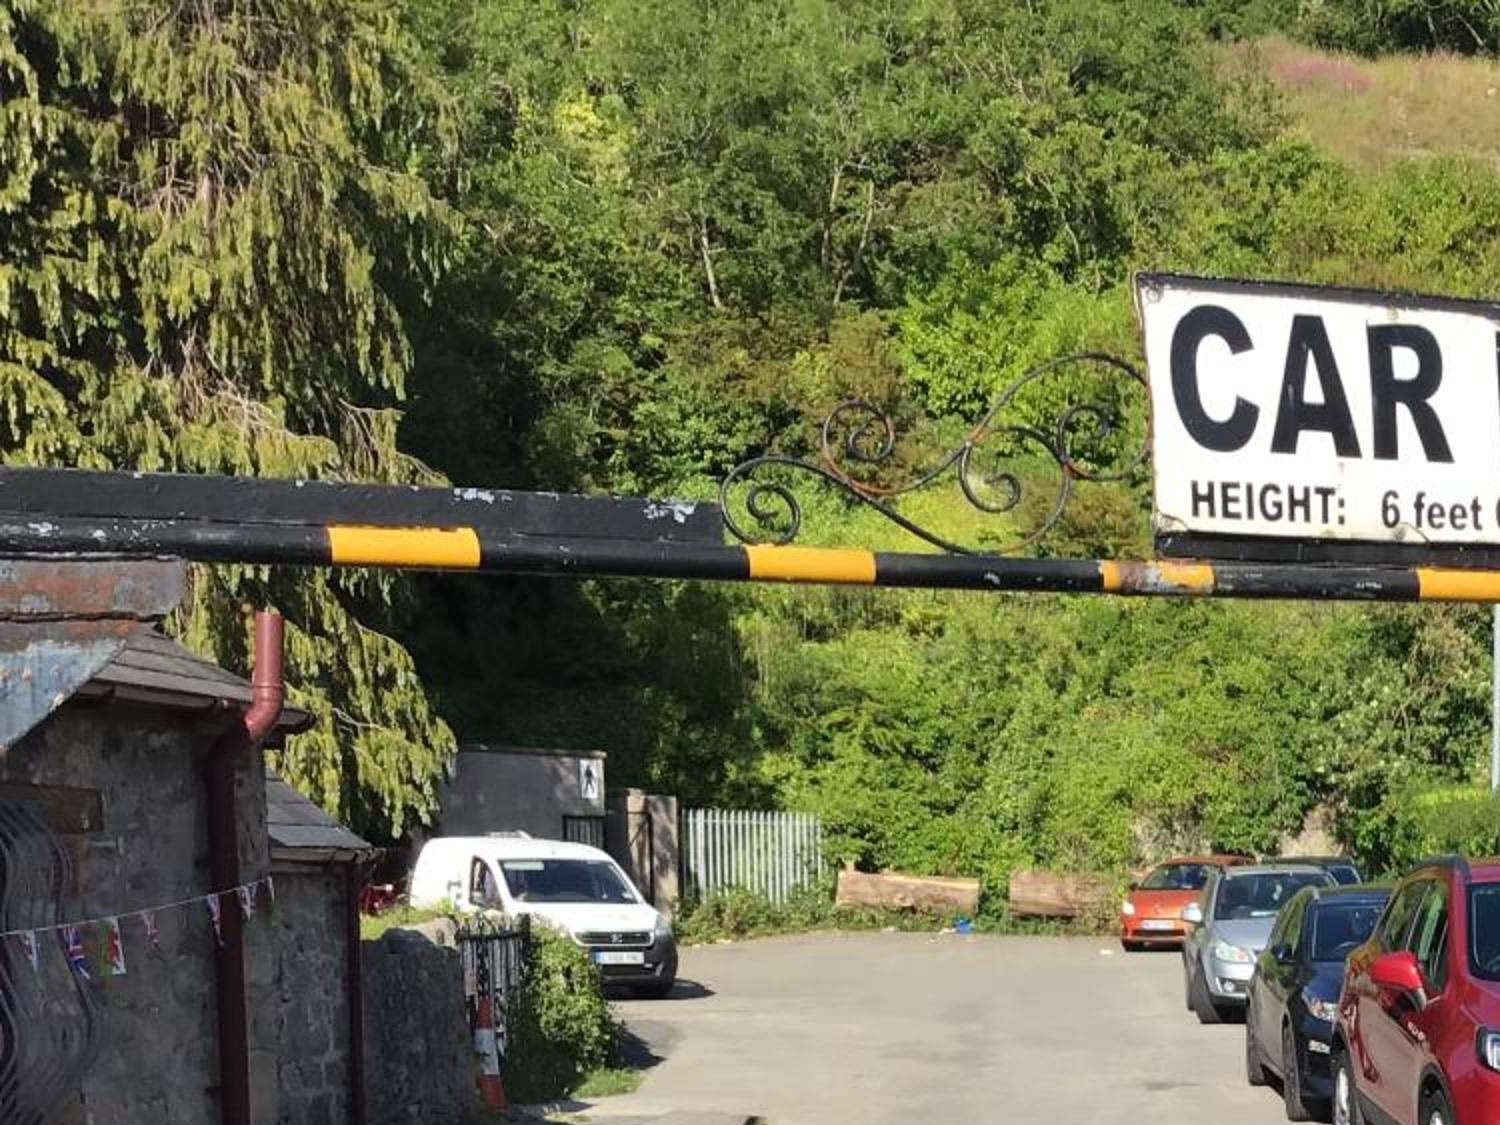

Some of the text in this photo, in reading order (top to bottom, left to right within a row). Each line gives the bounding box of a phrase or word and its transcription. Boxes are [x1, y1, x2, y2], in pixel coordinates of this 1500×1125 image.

[1169, 304, 1455, 465] CAR
[1190, 480, 1346, 526] HEIGHT:
[1381, 489, 1401, 528] 6
[1413, 491, 1483, 531] feet
